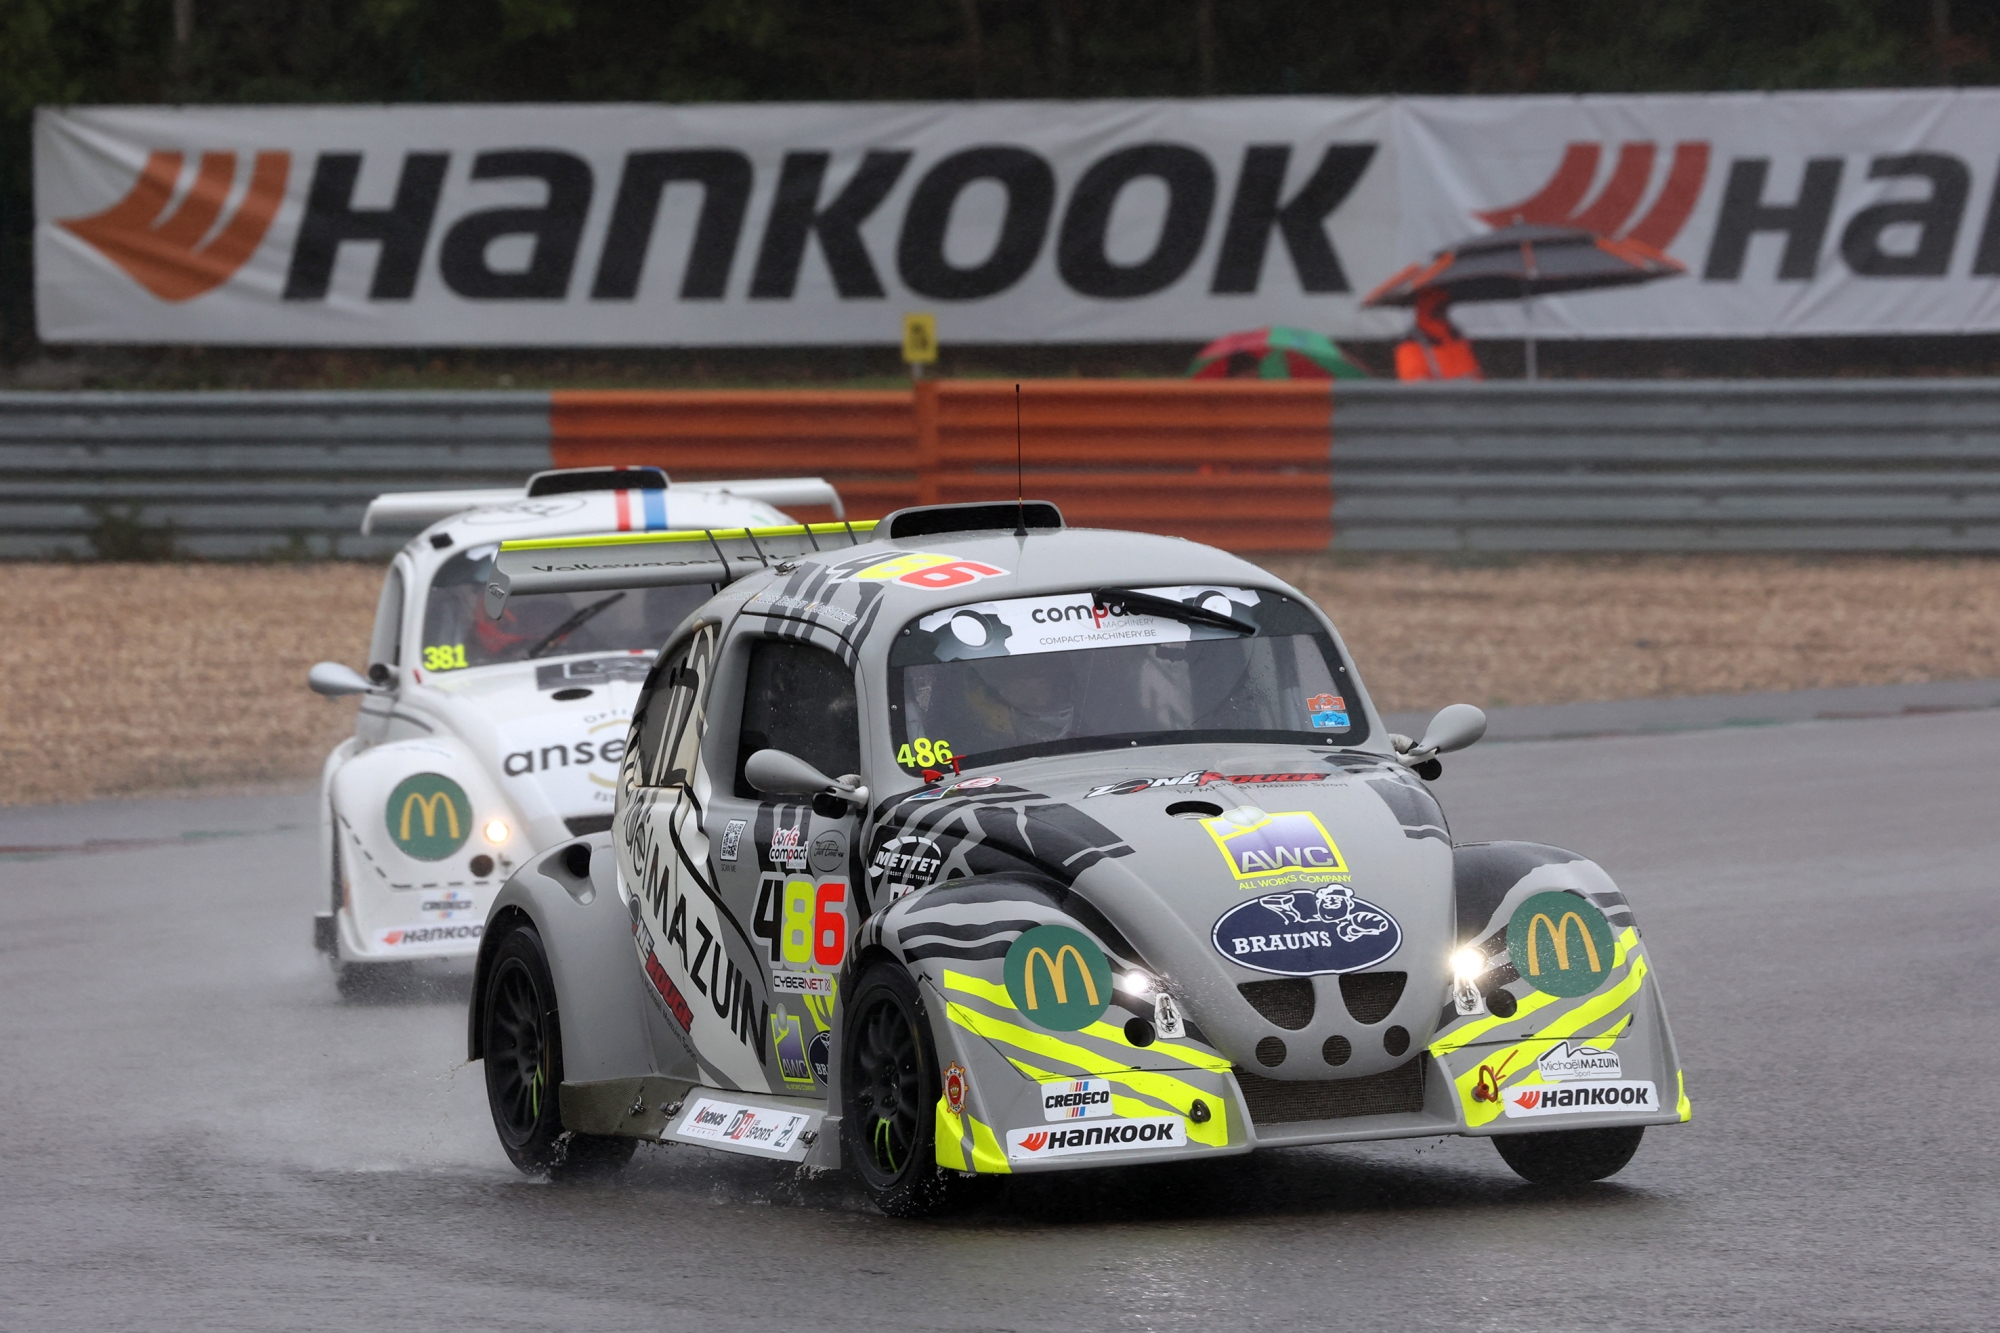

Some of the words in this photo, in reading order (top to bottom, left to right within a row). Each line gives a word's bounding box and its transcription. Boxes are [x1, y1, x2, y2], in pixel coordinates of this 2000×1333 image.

[1704, 148, 2000, 281] Ha
[833, 551, 1003, 588] 486
[1102, 618, 1154, 629] MACHINERY
[1039, 629, 1157, 645] COMPACT-MACHINERY.BE
[423, 643, 469, 670] 381
[896, 738, 953, 768] 486
[876, 851, 941, 873] METTET
[1242, 845, 1333, 873] AWC
[1239, 880, 1257, 890] ALL
[1258, 875, 1298, 888] WORKS
[1299, 873, 1351, 884] COMPANY
[752, 877, 846, 966] 486
[1232, 930, 1331, 955] BRAUNS
[782, 1058, 808, 1078] AWC
[1044, 1090, 1109, 1109] CREDECO
